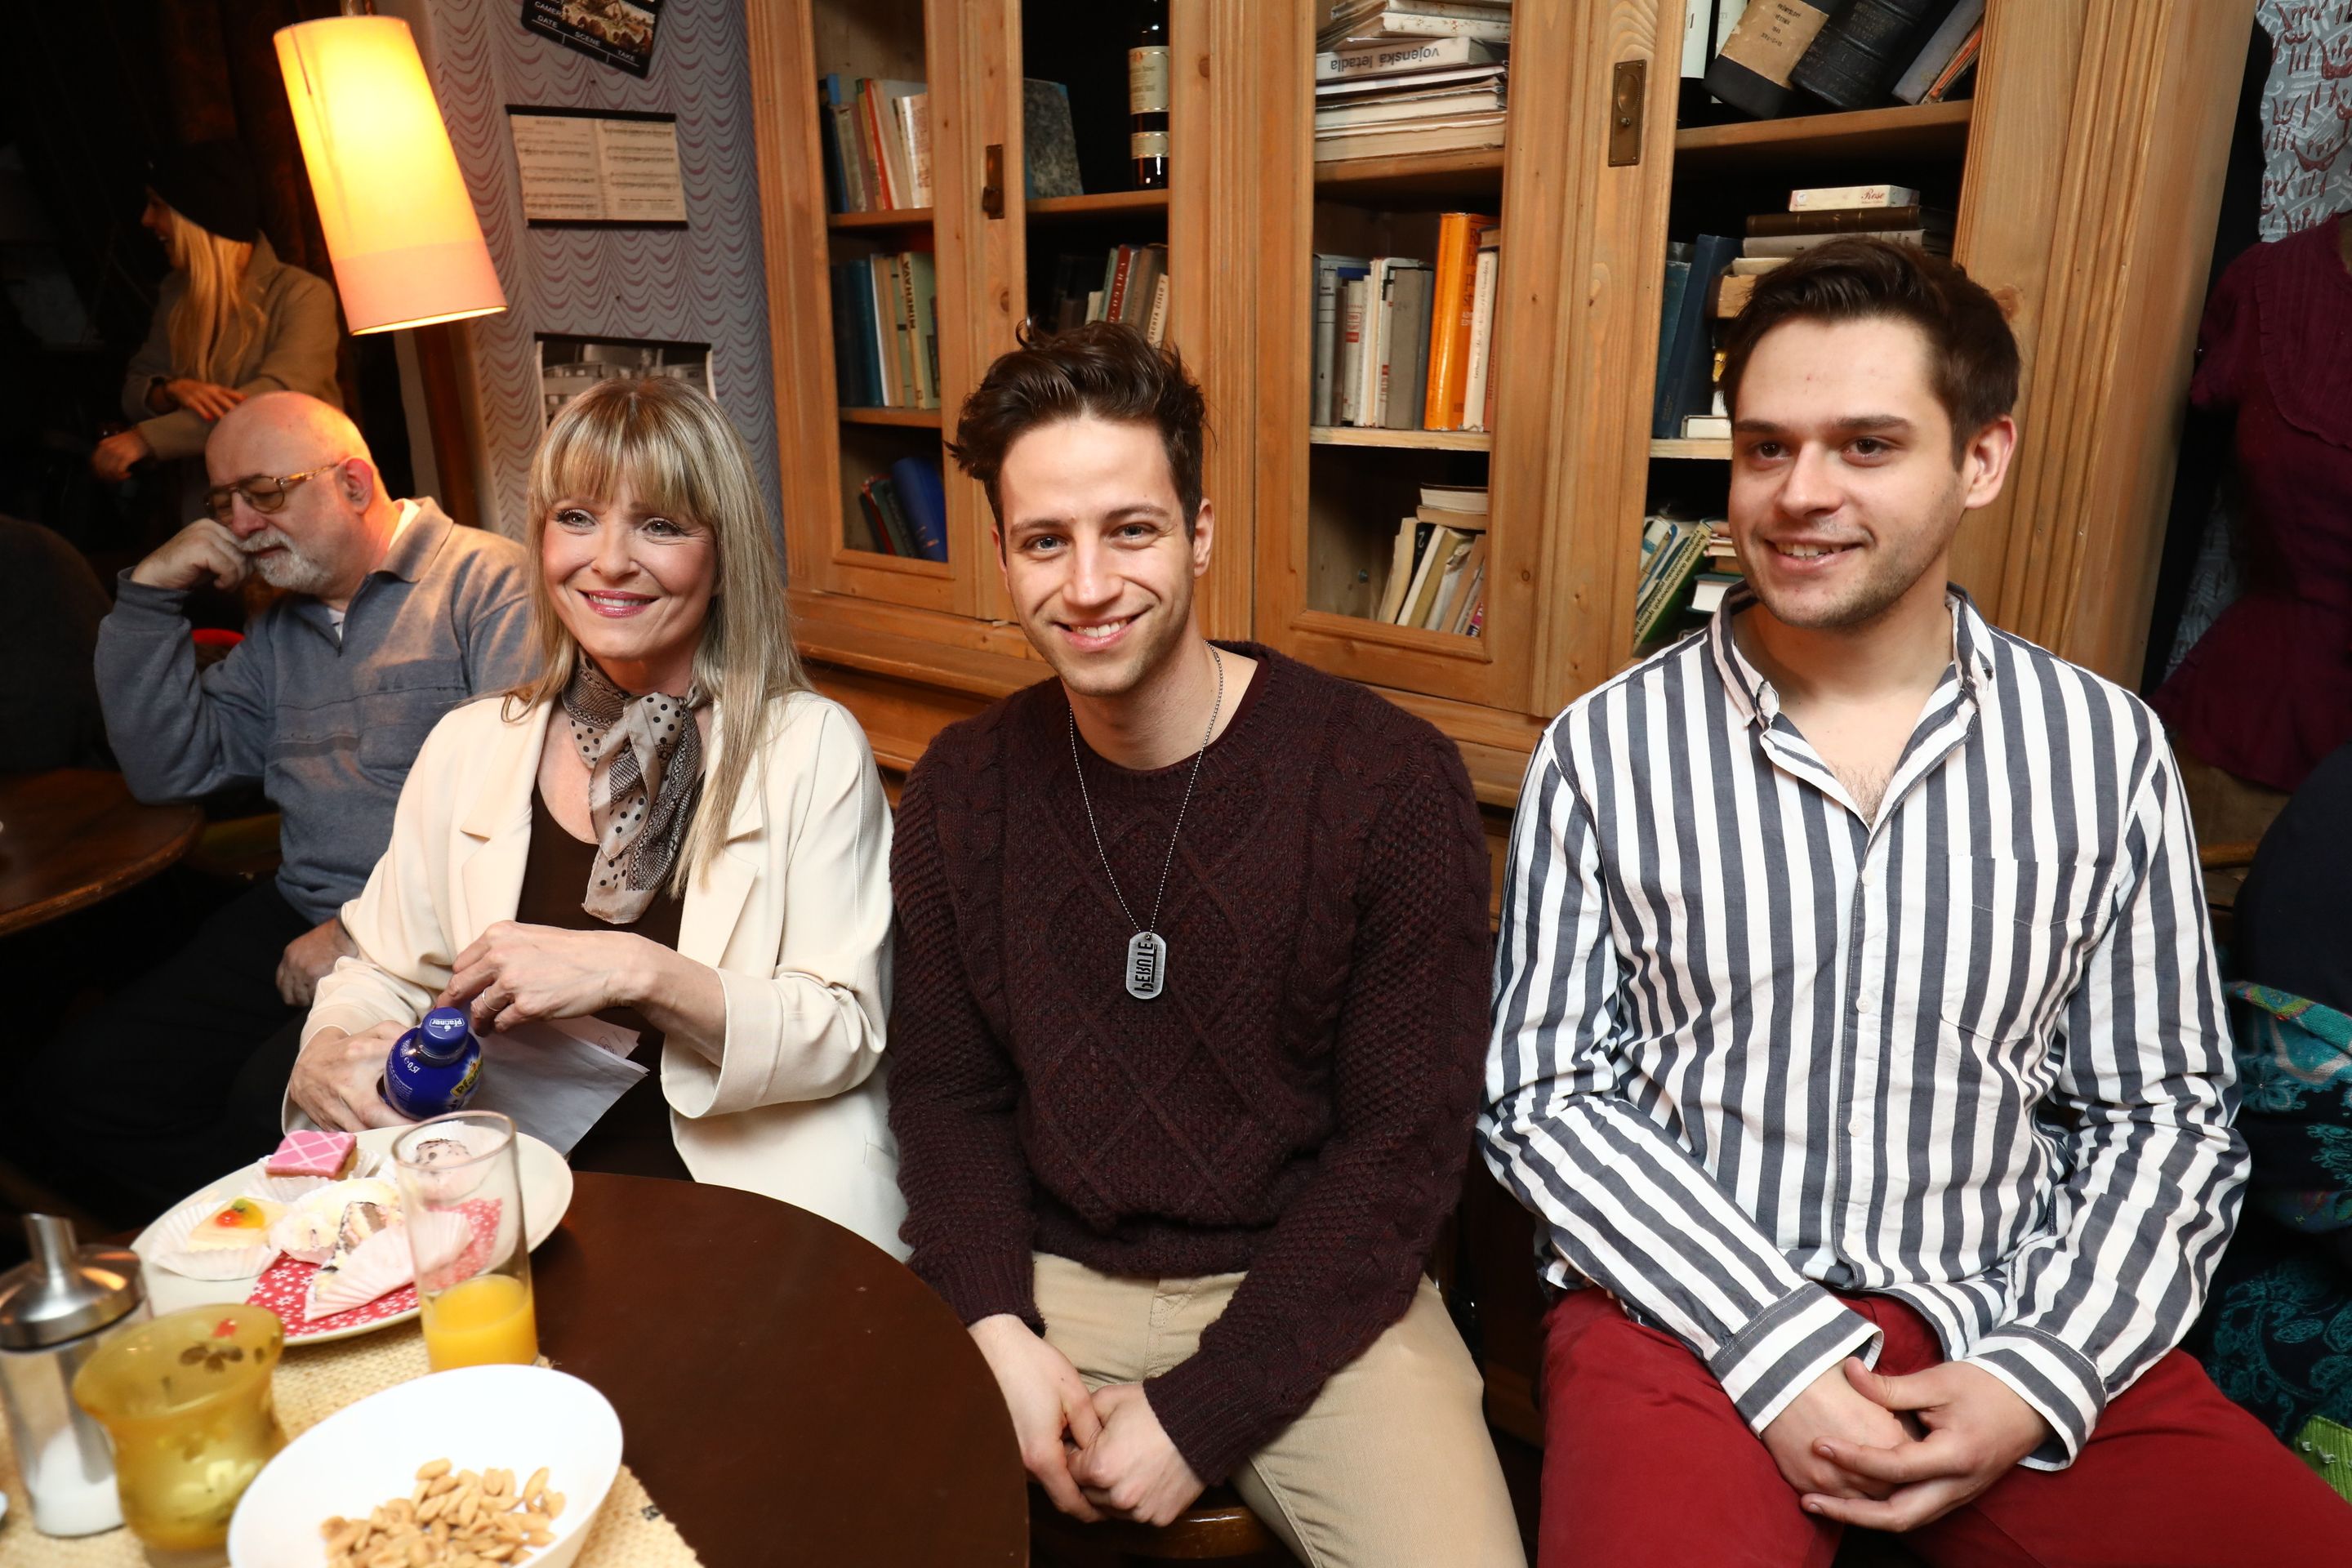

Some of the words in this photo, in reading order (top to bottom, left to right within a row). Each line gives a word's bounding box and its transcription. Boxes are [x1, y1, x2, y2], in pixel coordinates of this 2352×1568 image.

[537, 15, 558, 28] DATE
[574, 31, 601, 47] SCENE
[617, 50, 636, 61] TAKE
[1379, 46, 1440, 65] vojenská
[1330, 55, 1373, 73] letadla
[1860, 189, 1885, 200] Rose
[902, 261, 916, 329] MINEHAVA
